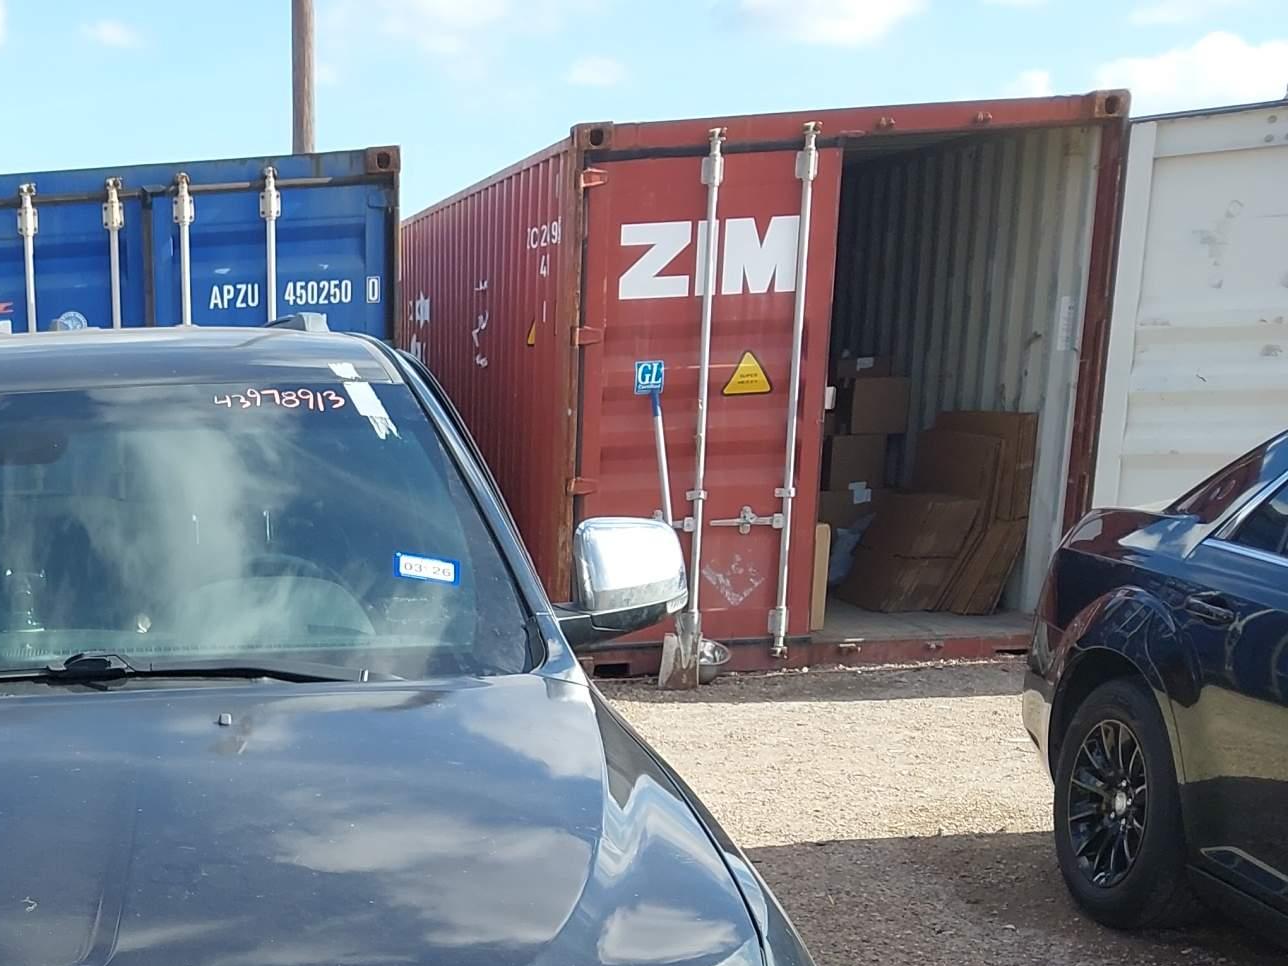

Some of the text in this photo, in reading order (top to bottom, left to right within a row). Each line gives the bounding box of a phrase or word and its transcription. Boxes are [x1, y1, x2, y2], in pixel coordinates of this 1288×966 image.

[619, 215, 801, 299] ZIM
[209, 283, 259, 310] APZU
[284, 280, 352, 306] 450250
[638, 363, 662, 384] GL
[214, 388, 345, 411] 43978913
